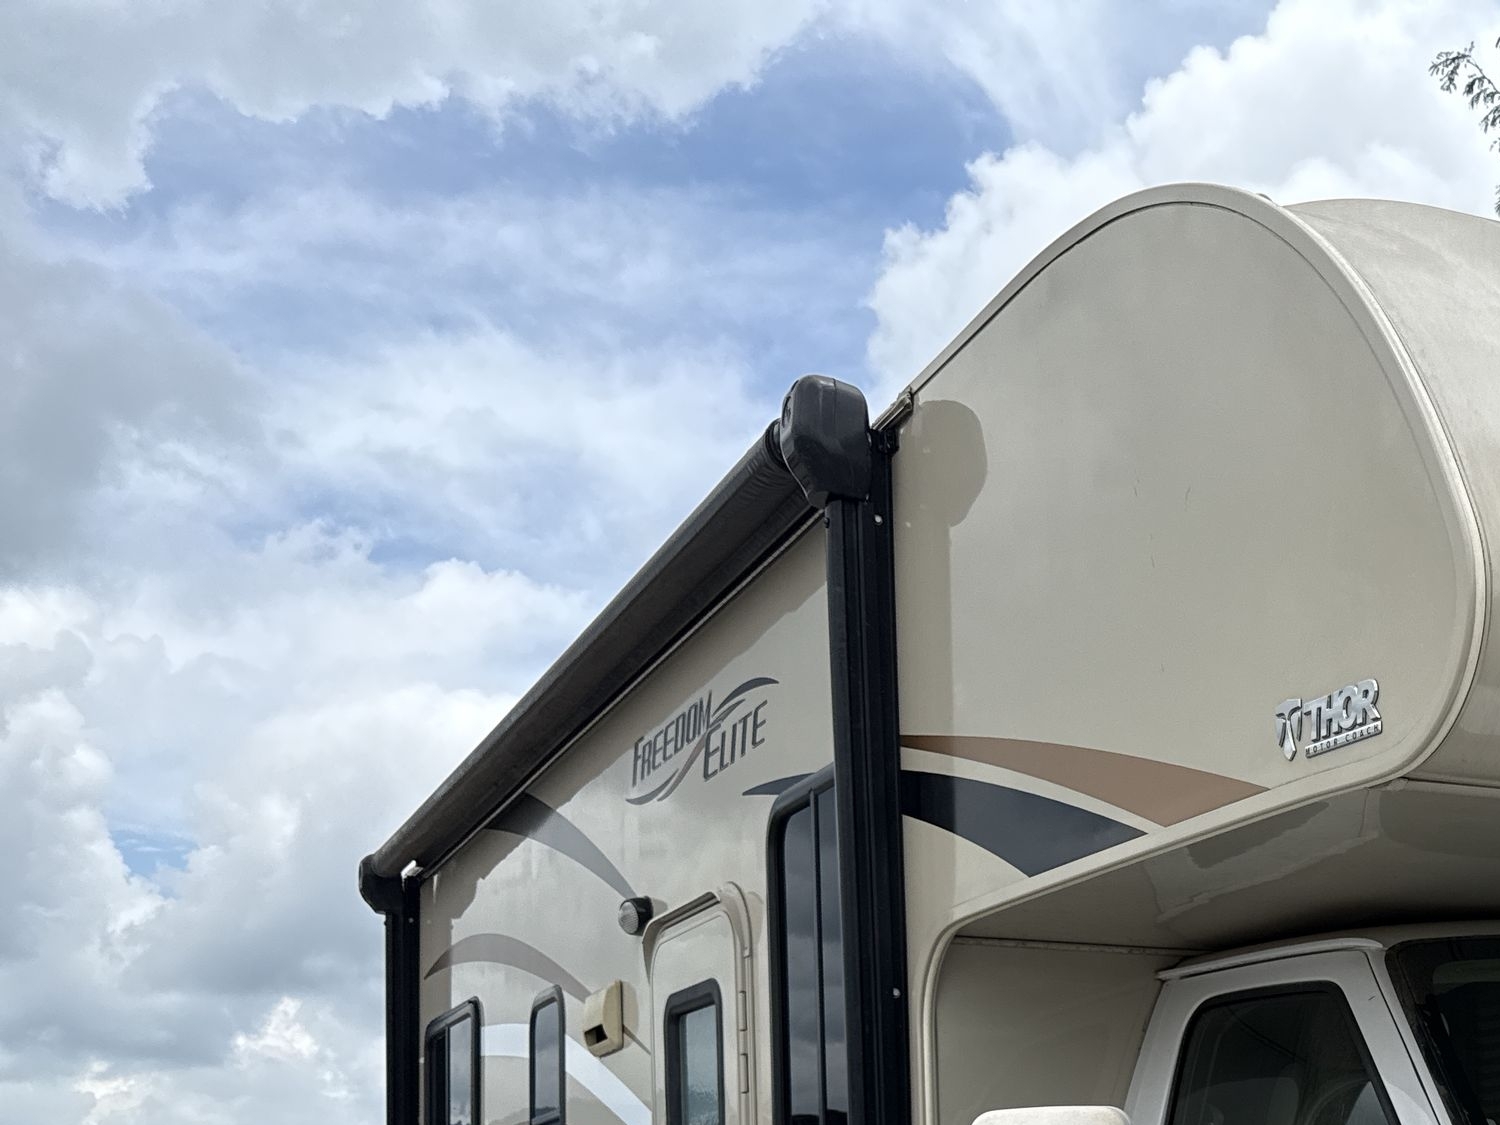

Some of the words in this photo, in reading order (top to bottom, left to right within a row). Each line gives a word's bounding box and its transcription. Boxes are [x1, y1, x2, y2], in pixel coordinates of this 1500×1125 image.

[631, 690, 713, 788] FREEDOM
[703, 700, 768, 782] ELITE
[1304, 678, 1381, 743] THOR
[1305, 738, 1338, 756] MOTOR
[1345, 724, 1381, 743] COACH
